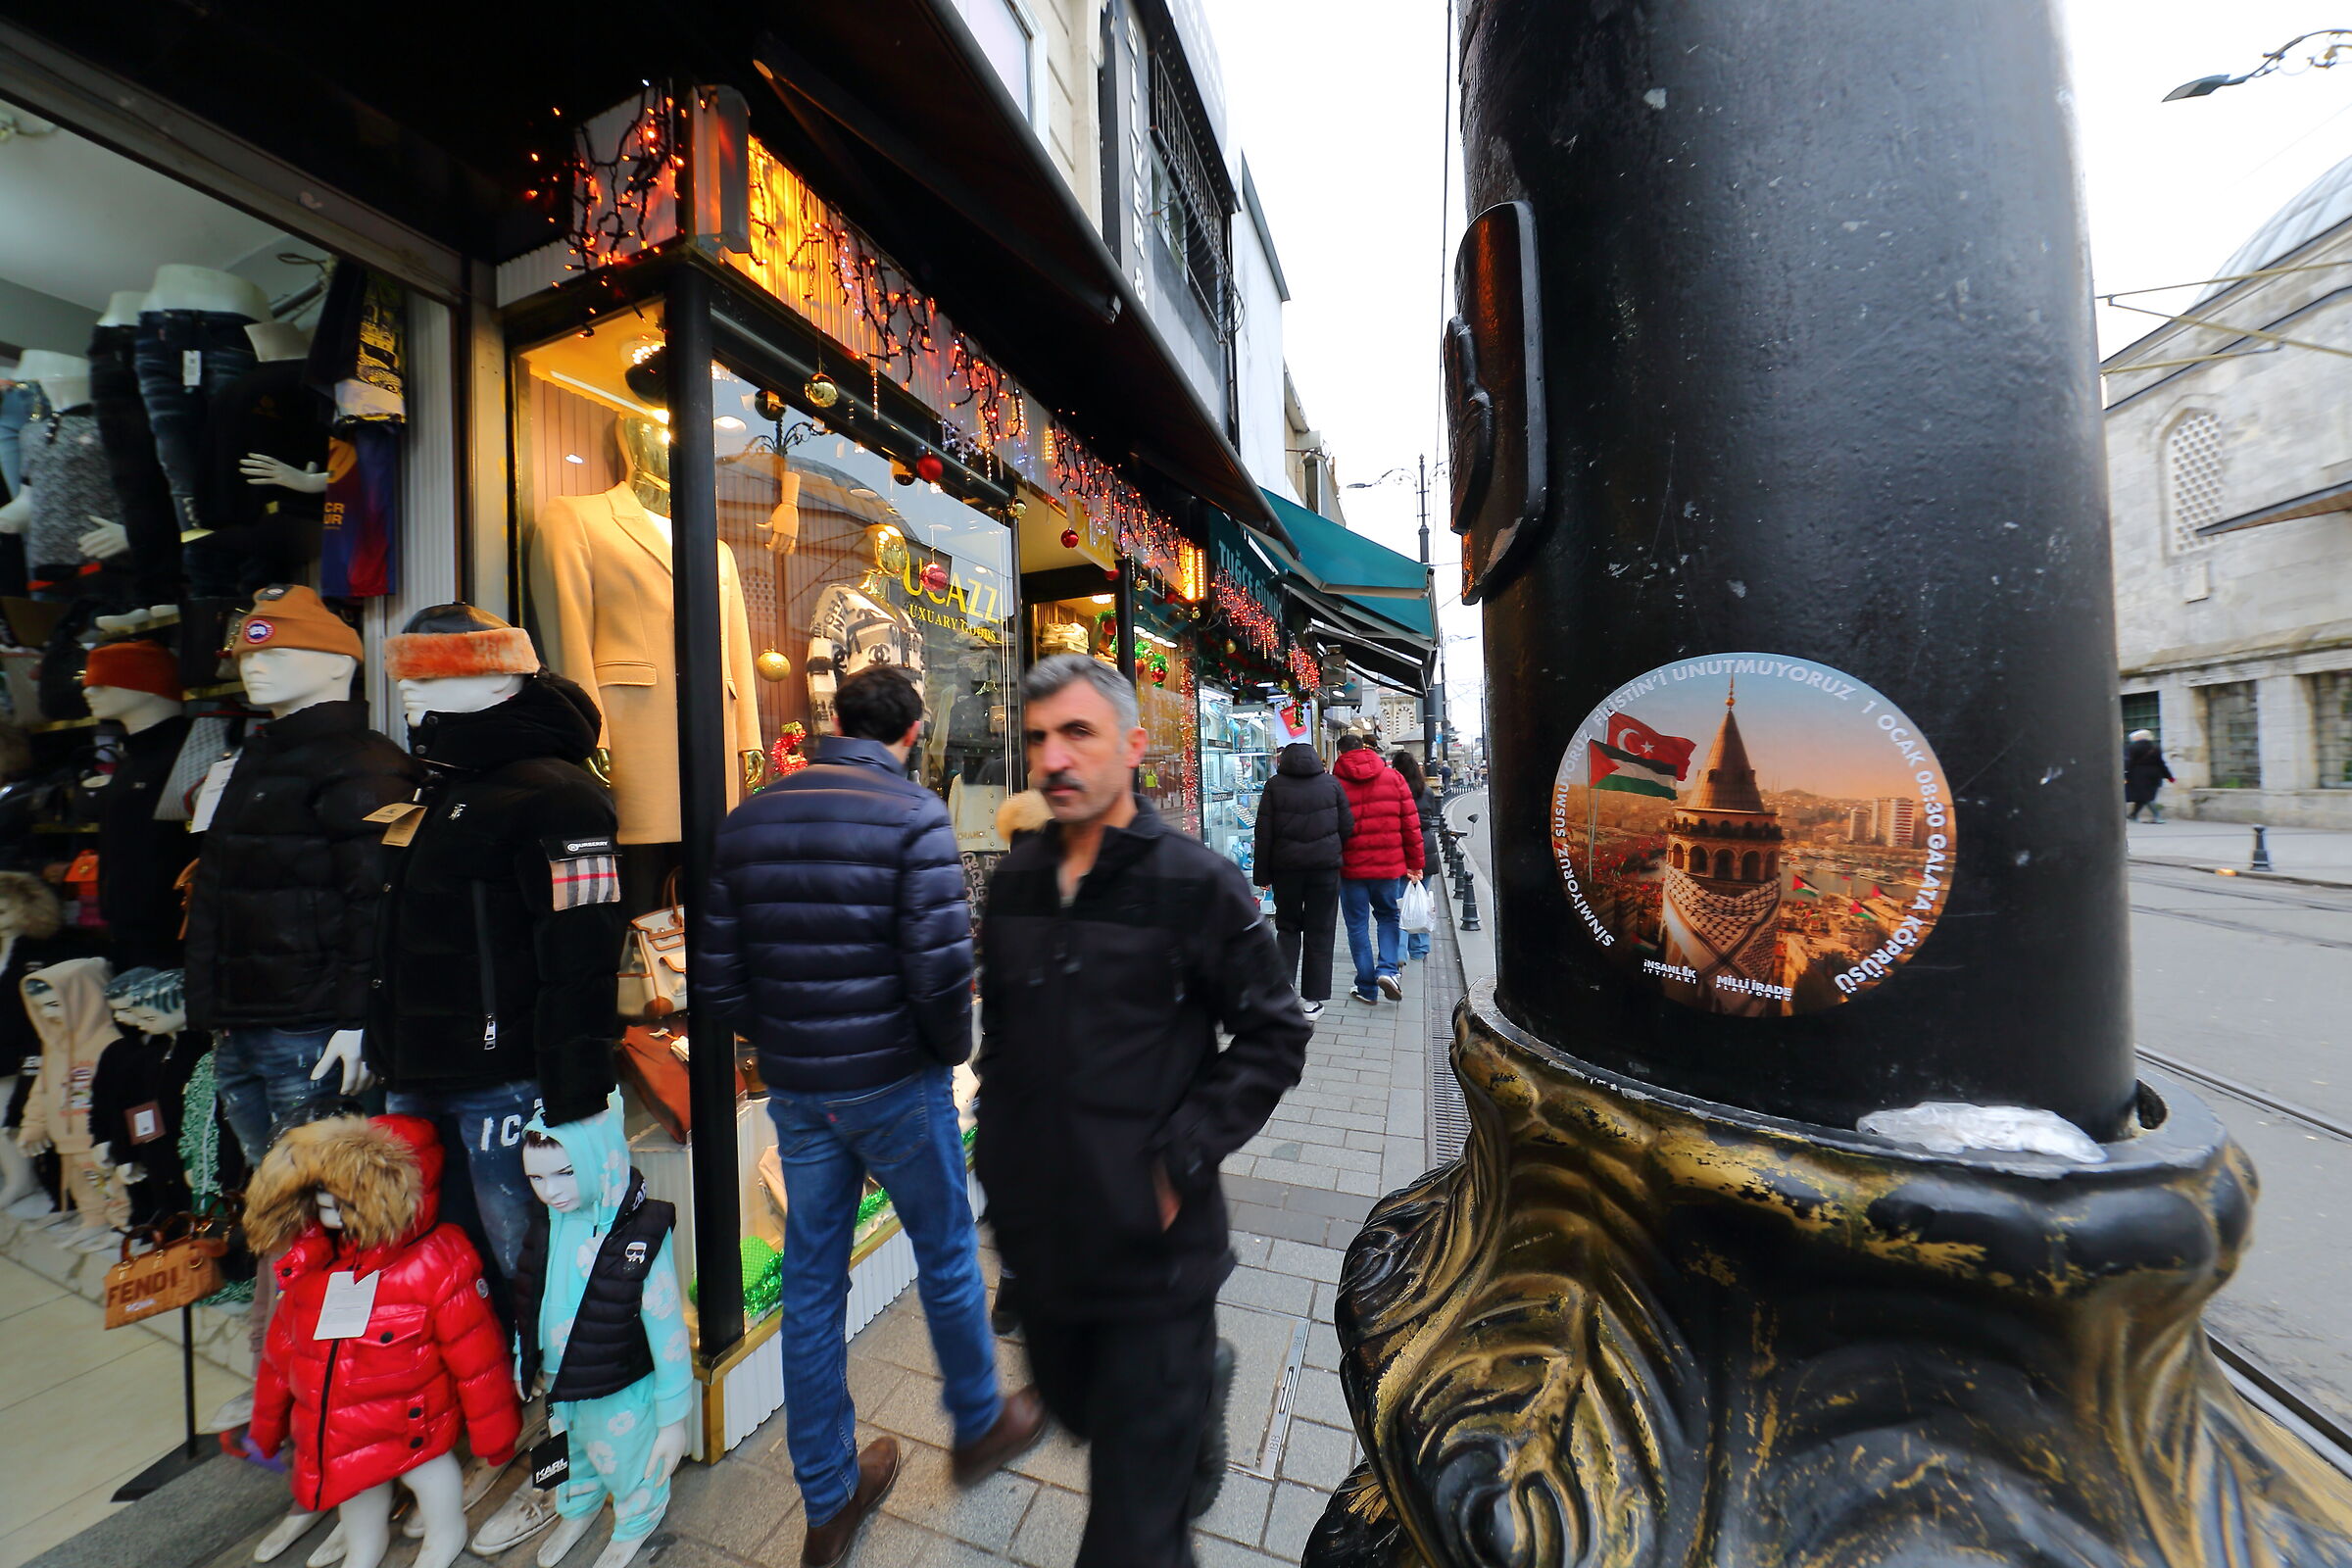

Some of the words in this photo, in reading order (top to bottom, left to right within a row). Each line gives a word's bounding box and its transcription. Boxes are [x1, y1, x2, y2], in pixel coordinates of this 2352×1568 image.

[1673, 660, 1857, 701] UNUTMUYORUZ
[1861, 701, 1878, 714] 1
[1878, 714, 1927, 767] OCAK
[1555, 729, 1592, 837] SUSMUYORUZ
[1915, 770, 1946, 827] 08:30
[1911, 834, 1947, 911] GALATA
[1834, 914, 1924, 994] KÖPRÜSÜ
[1716, 975, 1749, 990] MİLLİ
[1752, 979, 1792, 997] İRADE
[1716, 984, 1791, 1002] PLATFORMU
[107, 1266, 177, 1308] FENDI
[535, 1457, 567, 1483] KARL
